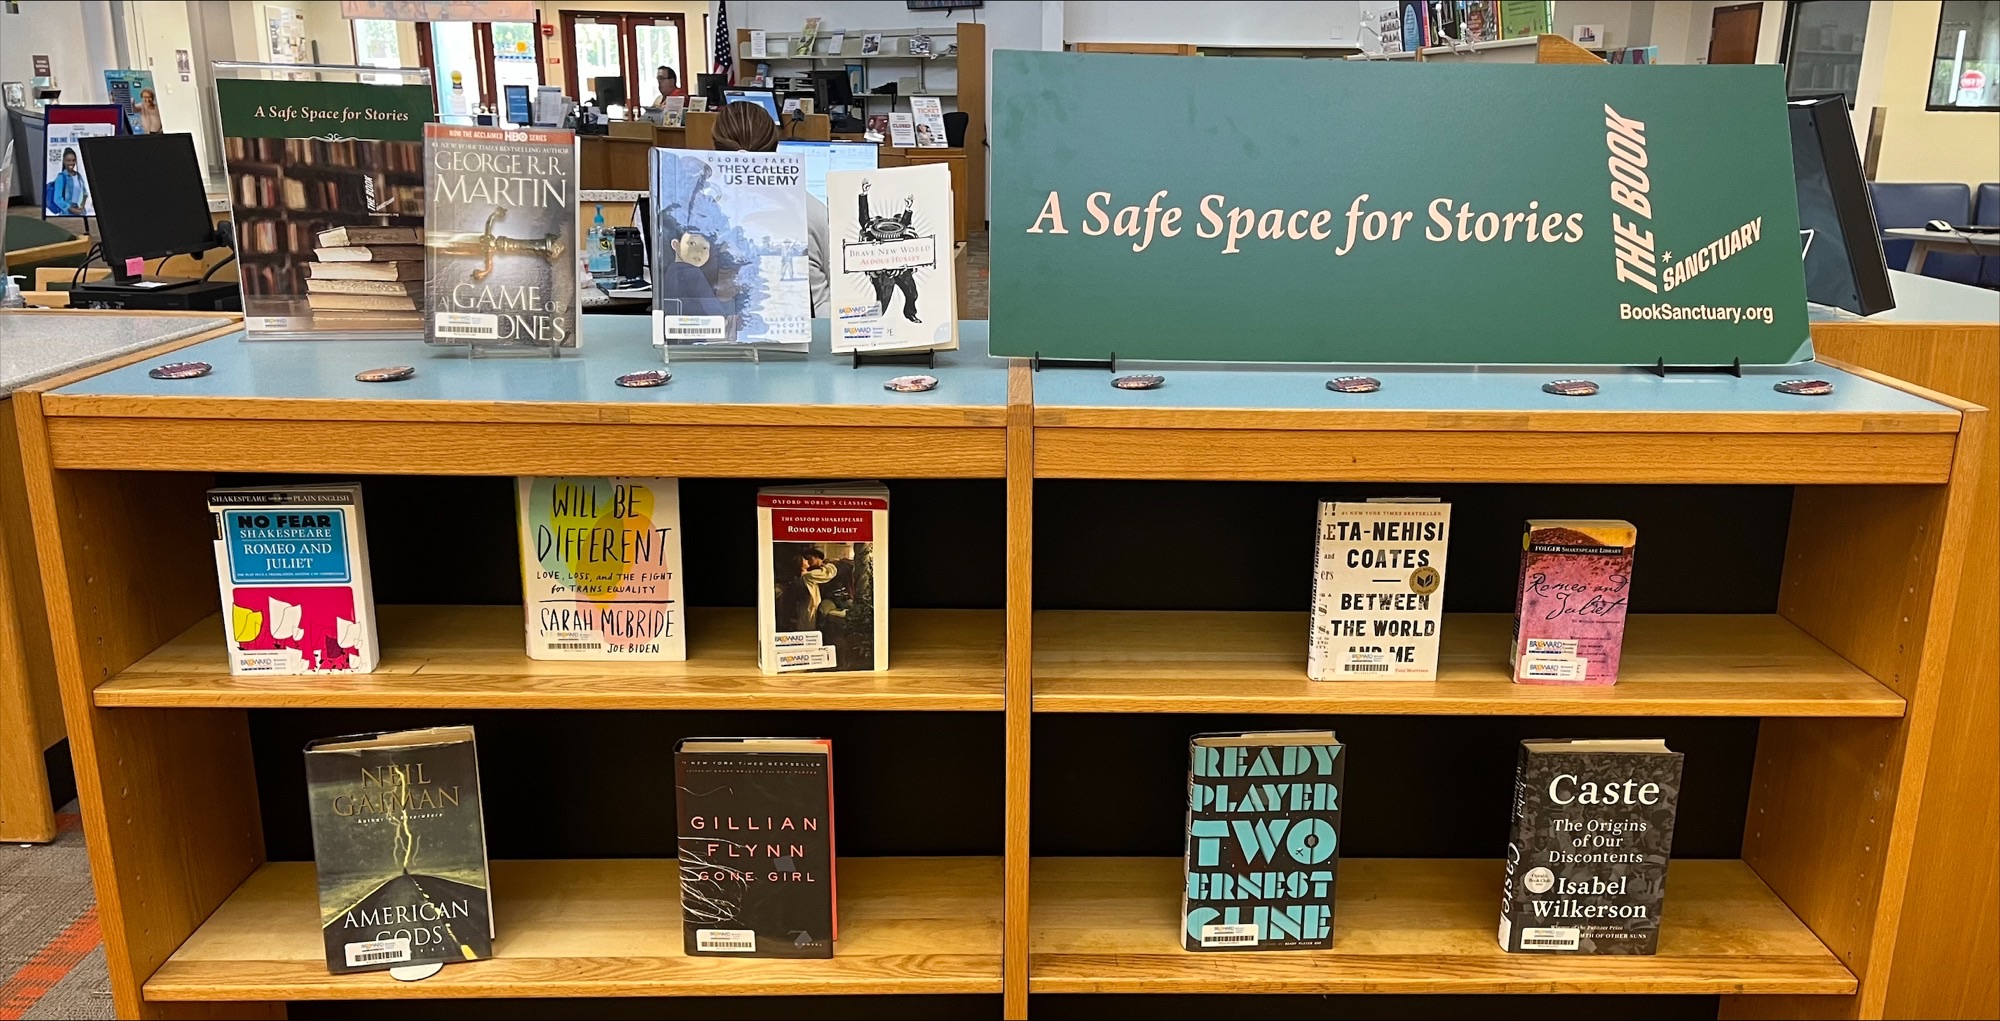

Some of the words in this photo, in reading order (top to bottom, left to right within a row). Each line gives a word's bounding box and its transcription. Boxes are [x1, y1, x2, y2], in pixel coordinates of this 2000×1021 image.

[255, 106, 265, 118] A
[269, 106, 297, 122] Safe
[301, 106, 339, 122] Space
[340, 107, 361, 123] for
[364, 108, 409, 122] Stories
[473, 131, 503, 140] ACCLAIMED
[504, 131, 528, 142] HBO
[529, 134, 547, 142] SERIES
[434, 150, 522, 174] GEORGE
[708, 156, 756, 164] GEORGE
[1604, 104, 1653, 219] BOOK
[718, 165, 750, 174] THEY
[754, 165, 799, 174] CALLED
[724, 175, 742, 185] US
[748, 176, 799, 186] ENEMY
[434, 174, 566, 208] MARTIN
[1026, 191, 1069, 234] A
[1082, 190, 1182, 252] Safe
[1196, 194, 1332, 254] Space
[1335, 194, 1413, 256] for
[1425, 198, 1584, 243] Stories
[878, 248, 898, 256] NEW
[900, 245, 931, 253] WORLD
[1613, 213, 1658, 294] THE
[1662, 216, 1762, 292] SANCTUARY
[860, 258, 889, 266] ALDOUS
[452, 283, 542, 311] GAME
[545, 301, 564, 312] OF
[839, 306, 866, 314] BROWARD
[1620, 303, 1774, 324] BookSanctuary.org
[553, 484, 597, 518] WILL
[614, 484, 643, 518] BE
[238, 515, 270, 528] NO
[276, 515, 332, 528] FEAR
[240, 529, 332, 538] SHAKESPEARE
[1337, 522, 1444, 541] TA-NEHISI
[244, 543, 296, 555] ROMEO
[300, 543, 332, 554] AND
[538, 525, 672, 566] DIFFERENT
[266, 558, 313, 570] JULIET
[1347, 549, 1430, 568] COATES
[537, 571, 564, 581] LOVE,
[568, 572, 592, 582] LOSS,
[596, 573, 612, 581] and
[616, 573, 635, 581] THE
[641, 572, 673, 581] FIGHT
[1526, 573, 1586, 597] Romeo
[1594, 575, 1628, 592] and
[551, 585, 565, 594] for
[607, 585, 656, 594] EQUALITY
[1341, 593, 1429, 610] BETWEEN
[1546, 592, 1628, 620] Juliet
[540, 608, 593, 637] SARAH
[601, 608, 674, 638] MCBRIDE
[1331, 620, 1366, 636] THE
[1374, 620, 1435, 637] WORLD
[607, 644, 624, 653] JOE
[629, 644, 659, 653] BIDEN
[1389, 646, 1415, 662] ME
[1194, 746, 1342, 777] READY
[361, 763, 431, 789] NEIL
[1192, 784, 1338, 812] PLAYER
[1549, 774, 1660, 805] Caste
[332, 786, 459, 817] GAIMAN
[691, 816, 817, 830] GILLIAN
[1553, 819, 1582, 832] The
[1587, 819, 1647, 835] Origins
[1191, 818, 1337, 867] TWO
[1572, 834, 1591, 847] of
[1593, 835, 1623, 847] Our
[707, 844, 804, 858] FLYNN
[1549, 851, 1643, 863] Discontents
[700, 872, 755, 881] GONE
[768, 872, 815, 882] GIRL
[1189, 871, 1333, 900] ERNEST
[1502, 842, 1520, 914] Caste
[1557, 876, 1627, 895] Isabel
[344, 900, 469, 929] AMERICAN
[1532, 900, 1646, 918] Wilkerson
